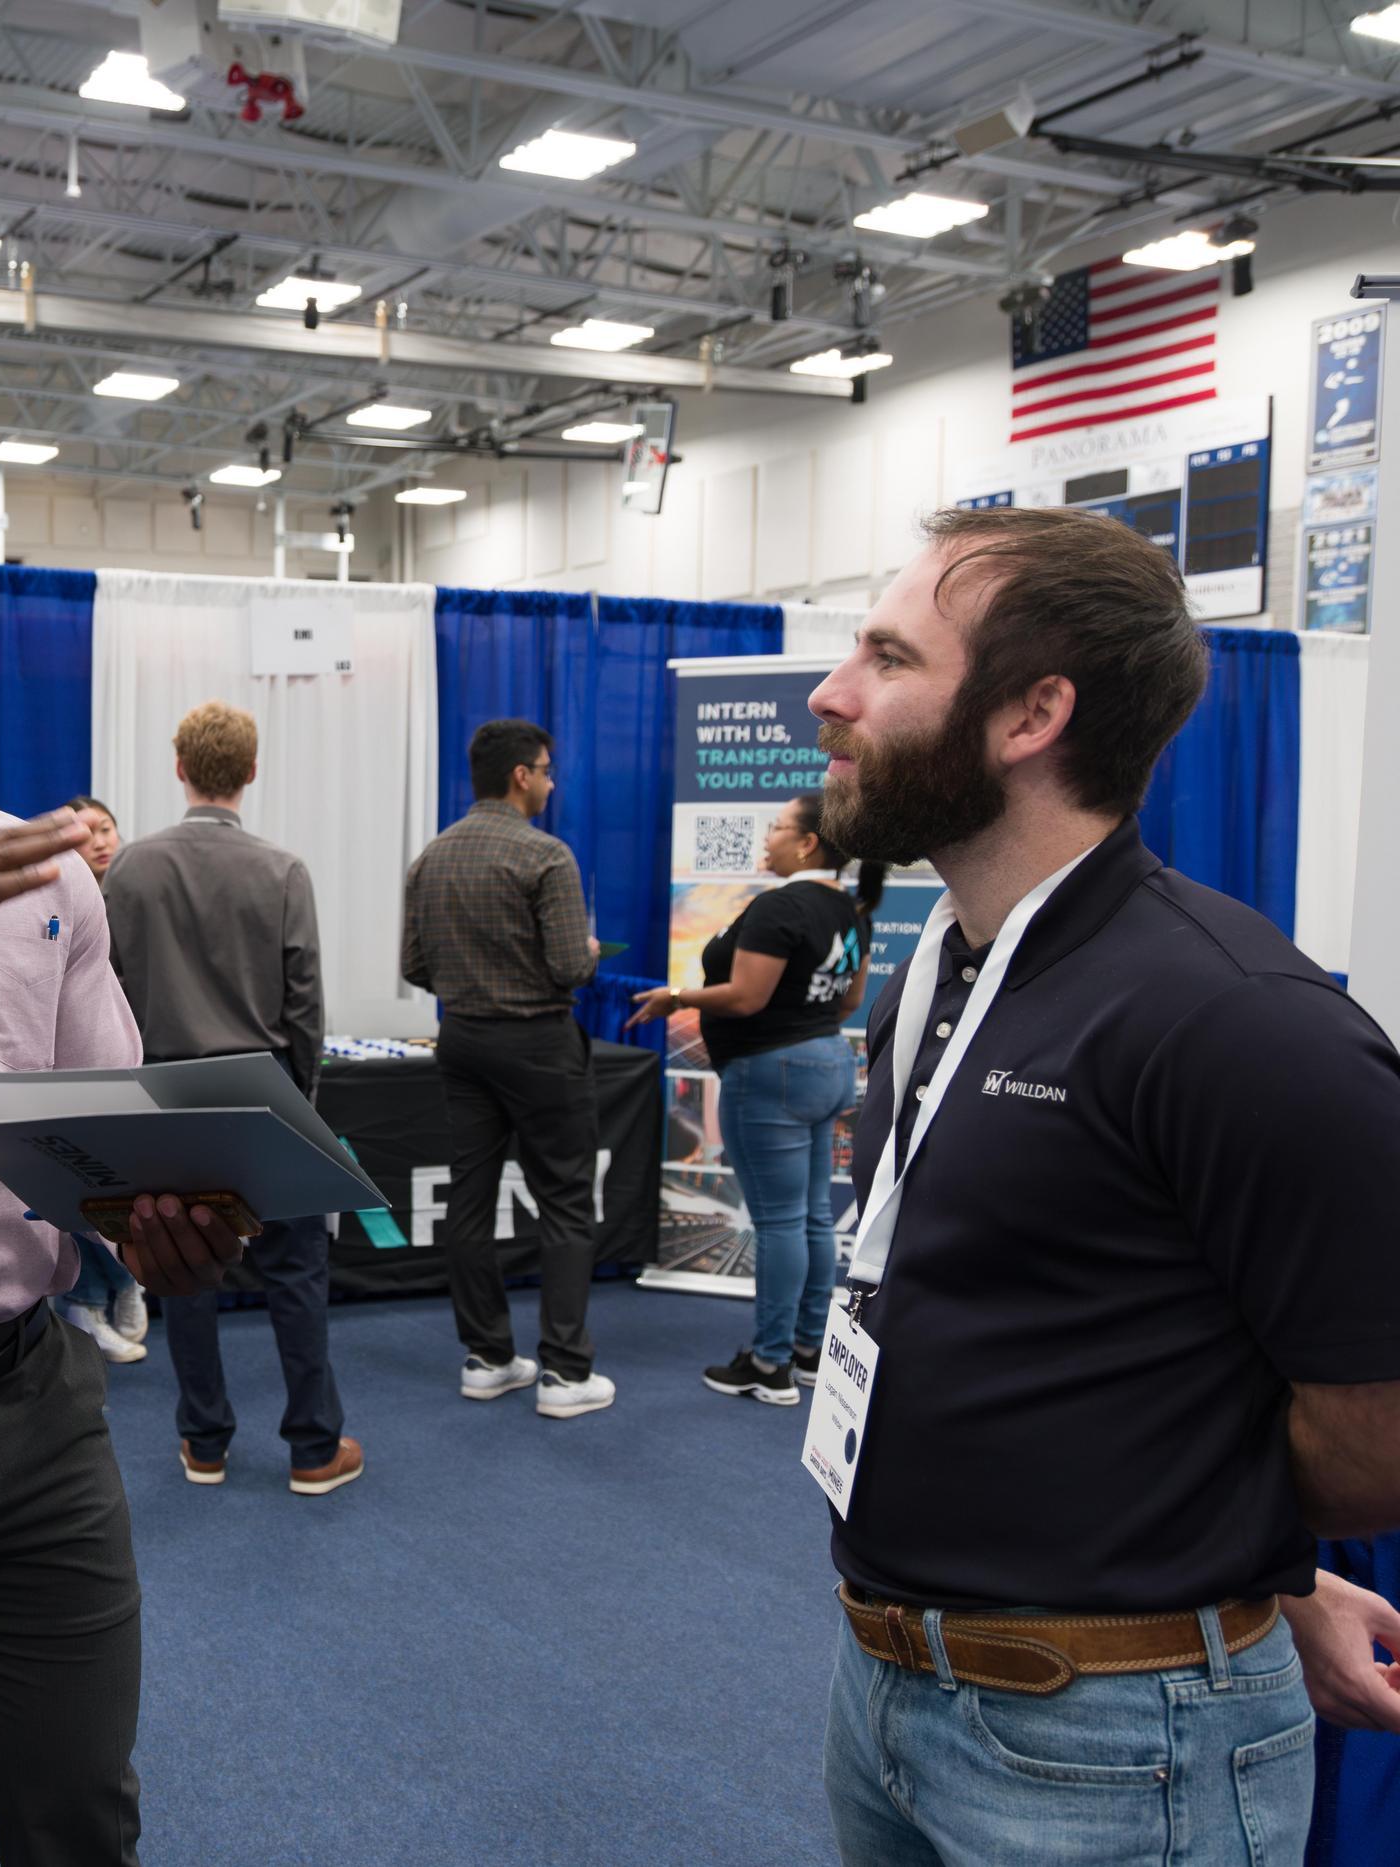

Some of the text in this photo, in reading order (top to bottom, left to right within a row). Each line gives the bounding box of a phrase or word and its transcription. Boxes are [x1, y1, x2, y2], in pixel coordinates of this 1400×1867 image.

[1031, 423, 1168, 469] PANORAMA
[697, 701, 777, 720] INTERN
[696, 725, 791, 744] WITH US,
[696, 772, 754, 789] YOUR
[1005, 1079, 1067, 1102] WILLDAN
[828, 1333, 868, 1394] EMPLOYER
